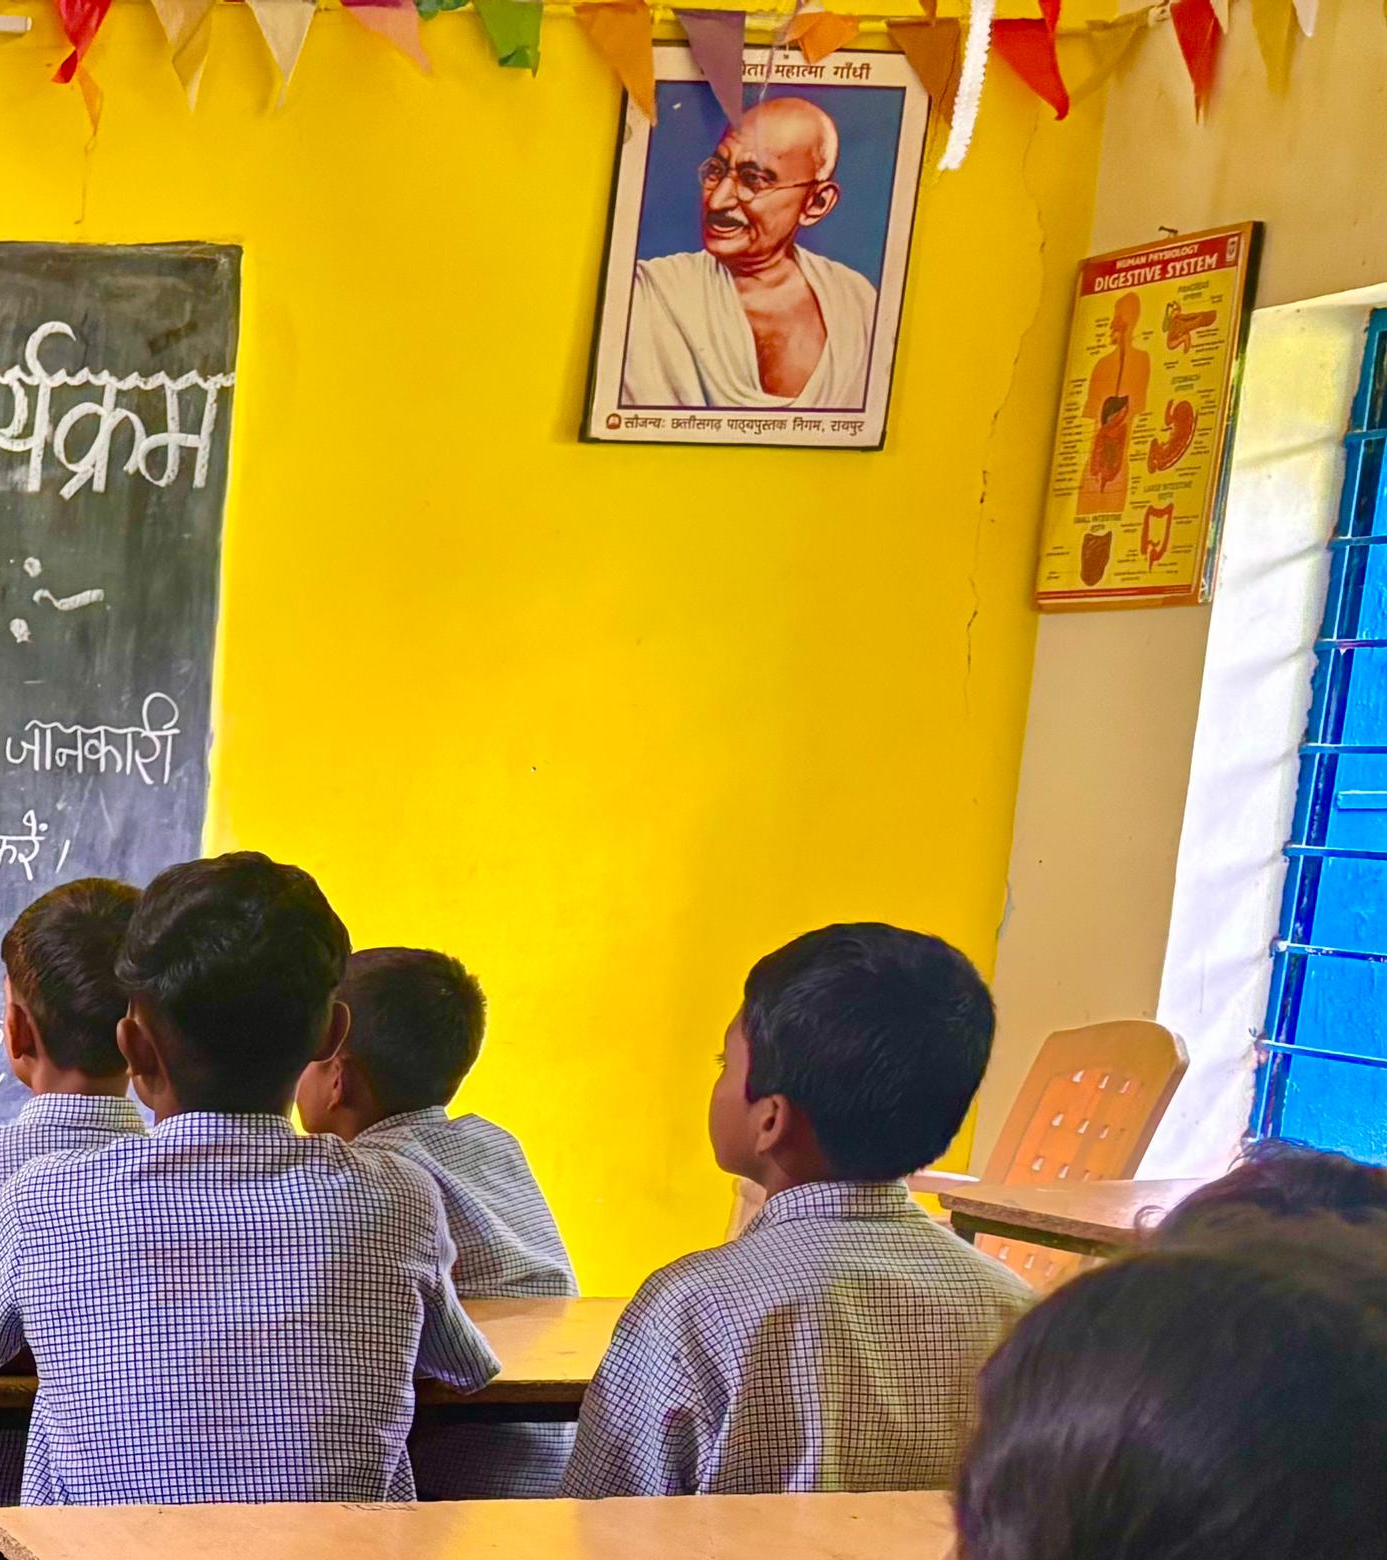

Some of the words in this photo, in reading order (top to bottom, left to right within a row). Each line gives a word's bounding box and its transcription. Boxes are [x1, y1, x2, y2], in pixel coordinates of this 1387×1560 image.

[774, 62, 825, 80] महात्मा
[1116, 253, 1147, 270] HUMAN
[1147, 243, 1200, 265] PHYSIOLOGY
[1093, 264, 1163, 293] DIGESTIVE
[1164, 252, 1219, 279] SYSTEM
[830, 419, 866, 436] रायपुर
[5, 692, 181, 785] जानकारी
